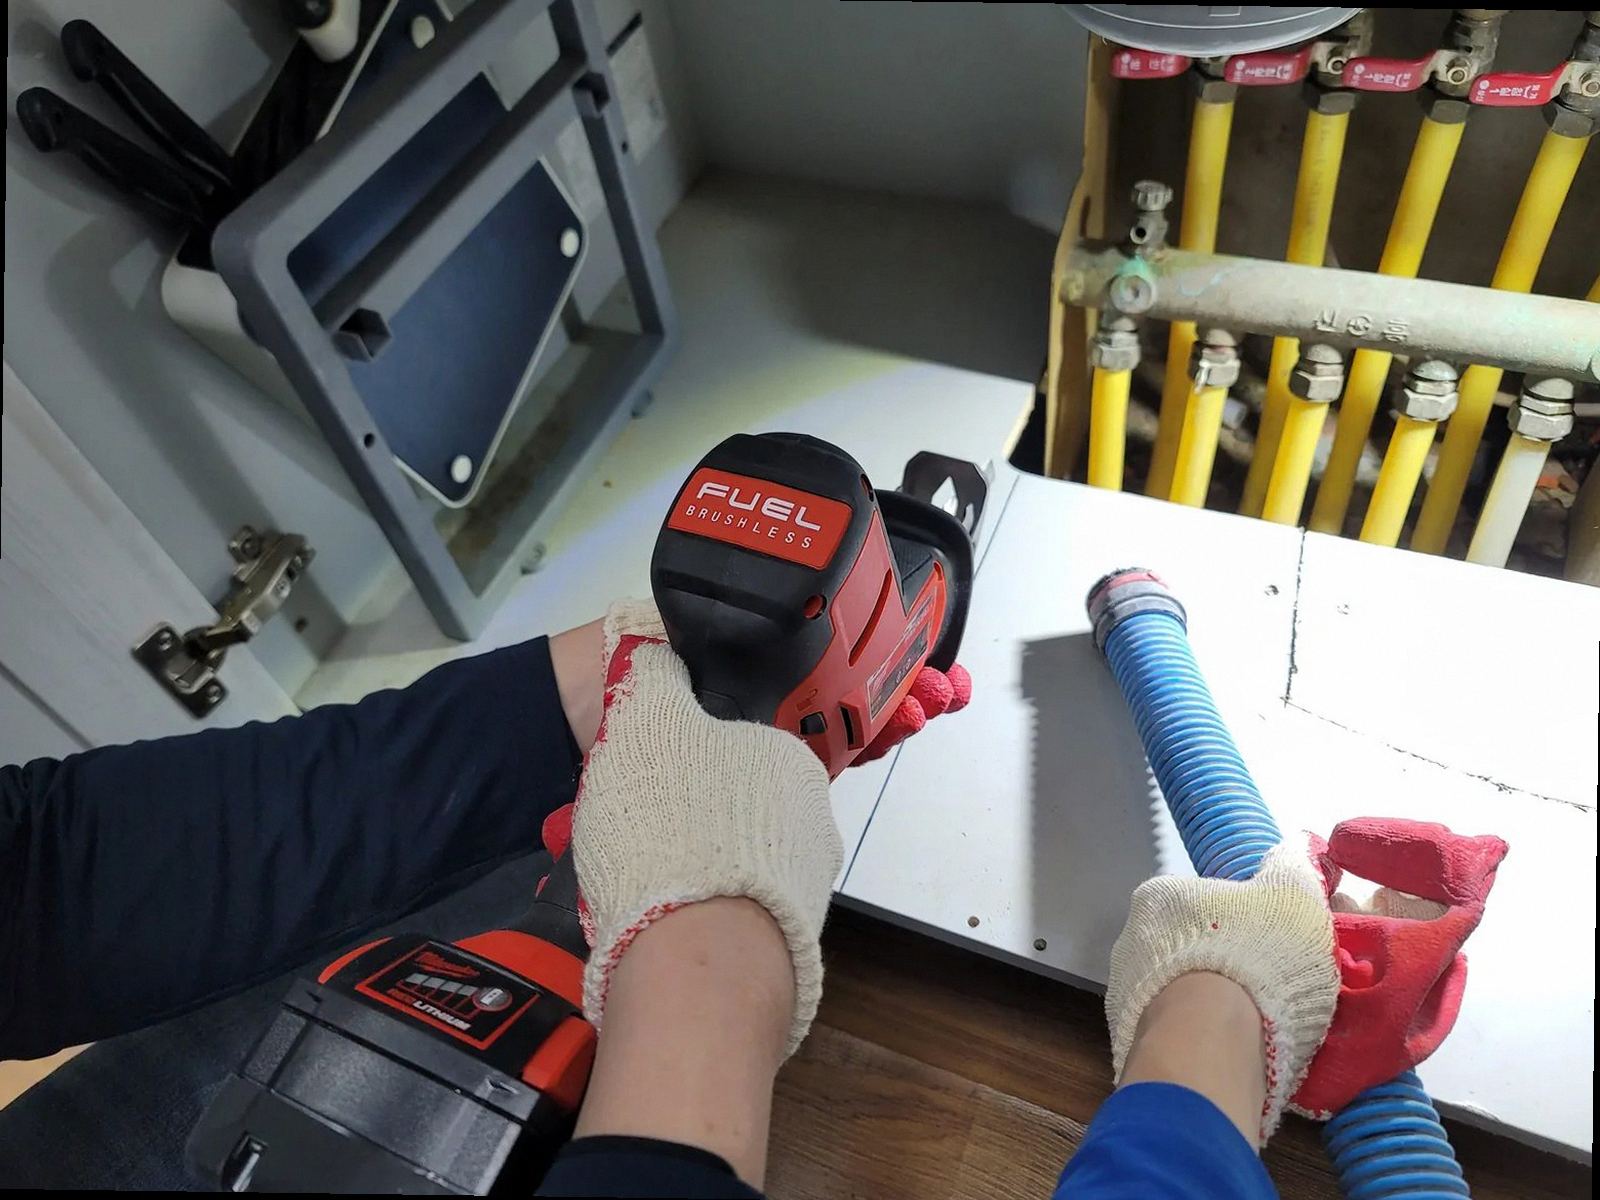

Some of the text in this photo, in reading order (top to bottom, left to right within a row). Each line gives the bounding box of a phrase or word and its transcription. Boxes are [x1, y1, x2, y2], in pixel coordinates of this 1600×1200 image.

[685, 505, 813, 549] BRUSHLESS
[696, 482, 821, 532] FUEL
[412, 1000, 472, 1031] LITHIUM
